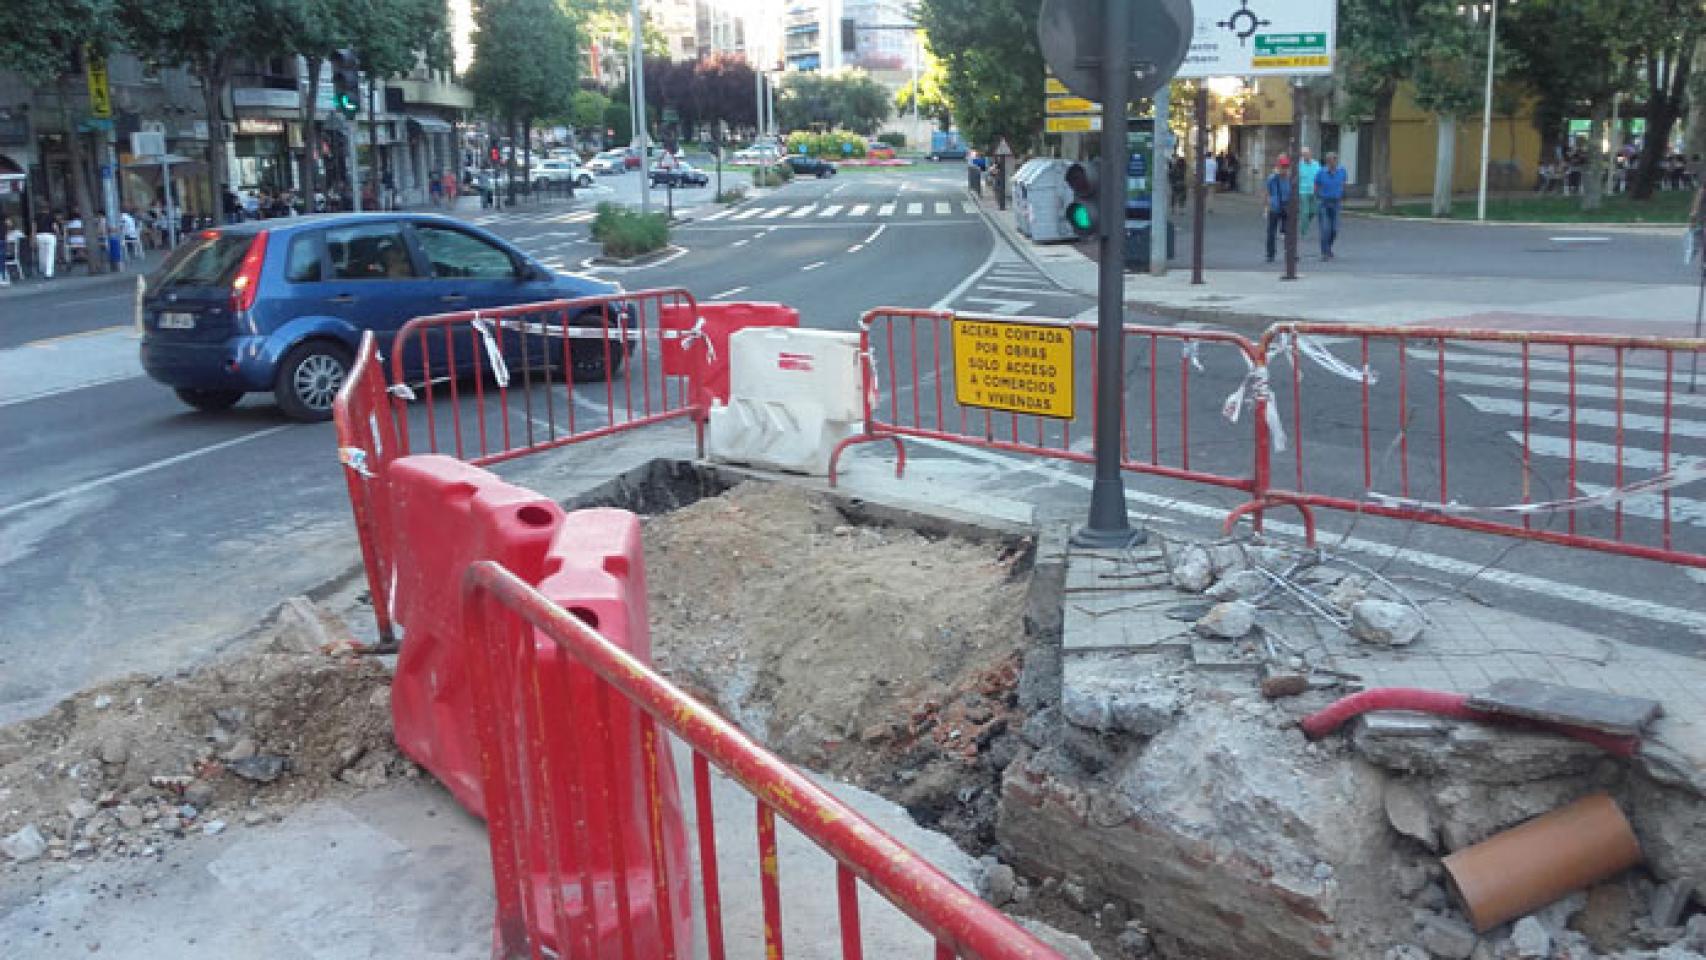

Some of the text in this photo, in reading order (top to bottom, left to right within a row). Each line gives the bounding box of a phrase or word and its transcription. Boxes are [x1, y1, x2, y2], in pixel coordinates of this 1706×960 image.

[961, 325, 1064, 343] ACERA CORTADA
[976, 342, 1047, 360] POR OBRAS
[968, 356, 1057, 378] SOLO ACCESO
[970, 374, 1057, 395] A COMERCIOS
[988, 392, 1052, 410] VIVIENDAS
